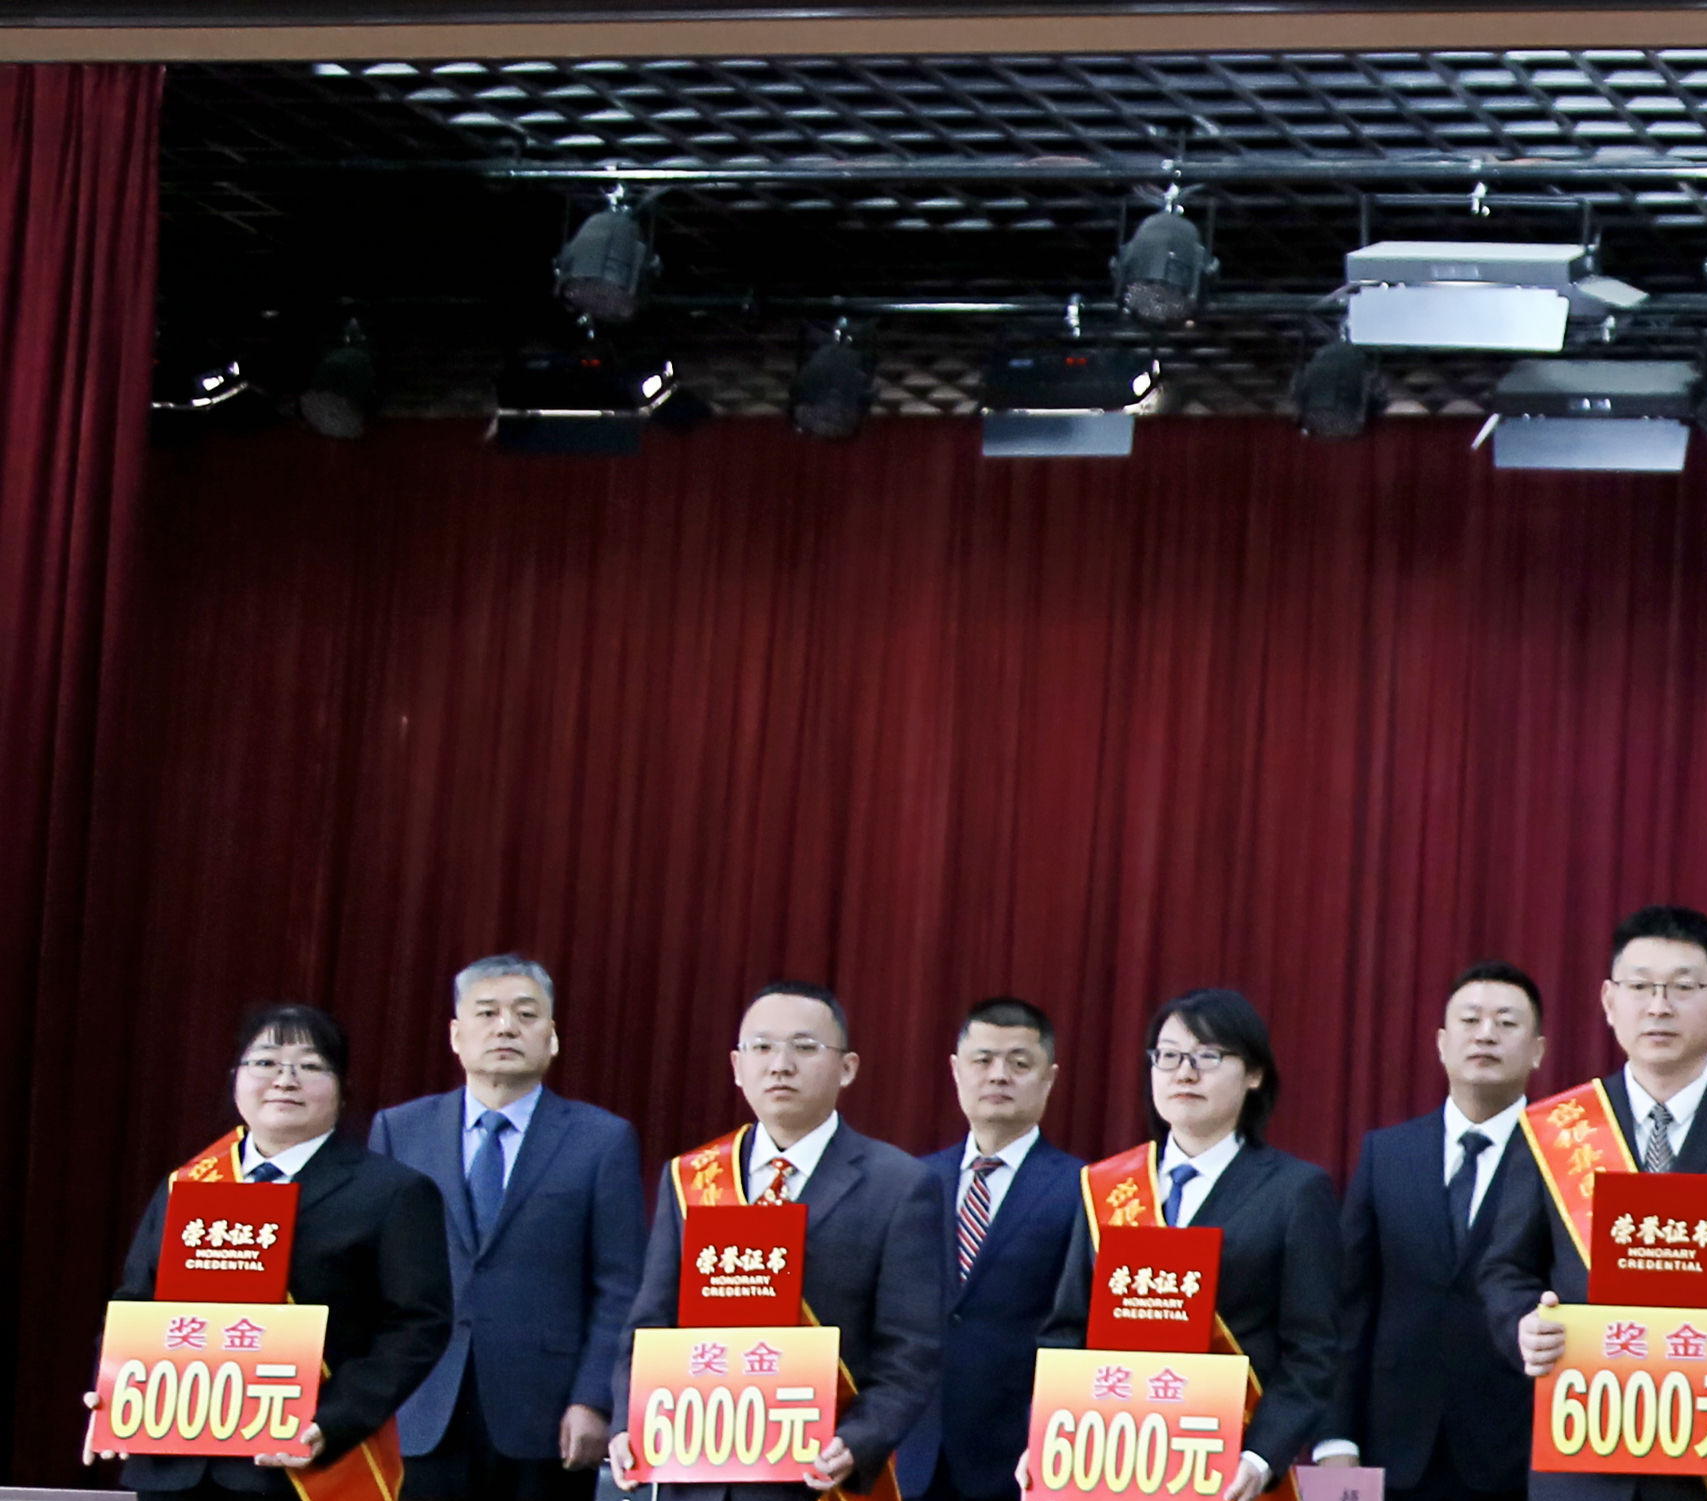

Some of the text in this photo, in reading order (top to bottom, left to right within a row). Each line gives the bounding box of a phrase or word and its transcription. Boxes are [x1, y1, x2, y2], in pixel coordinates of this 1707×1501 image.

[182, 1218, 278, 1249] 荣誉证书
[186, 1259, 264, 1270] CREDENTIAL
[196, 1249, 259, 1259] HONORARY
[697, 1245, 787, 1274] 荣誉证书
[1618, 1258, 1703, 1272] CREDENTIAL
[1628, 1248, 1696, 1259] HONORARY
[702, 1286, 776, 1297] CREDENTIAL
[710, 1276, 770, 1285] HONORARY
[1109, 1265, 1201, 1298] 荣誉证书
[1113, 1308, 1189, 1321] CREDENTIAL
[1123, 1297, 1184, 1309] HONORARY
[165, 1316, 265, 1352] 奖金
[689, 1341, 782, 1377] 奖金
[1092, 1364, 1188, 1402] 奖金
[110, 1360, 302, 1440] 6000元
[643, 1386, 820, 1467] 6000元
[1041, 1408, 1224, 1495] 6000元
